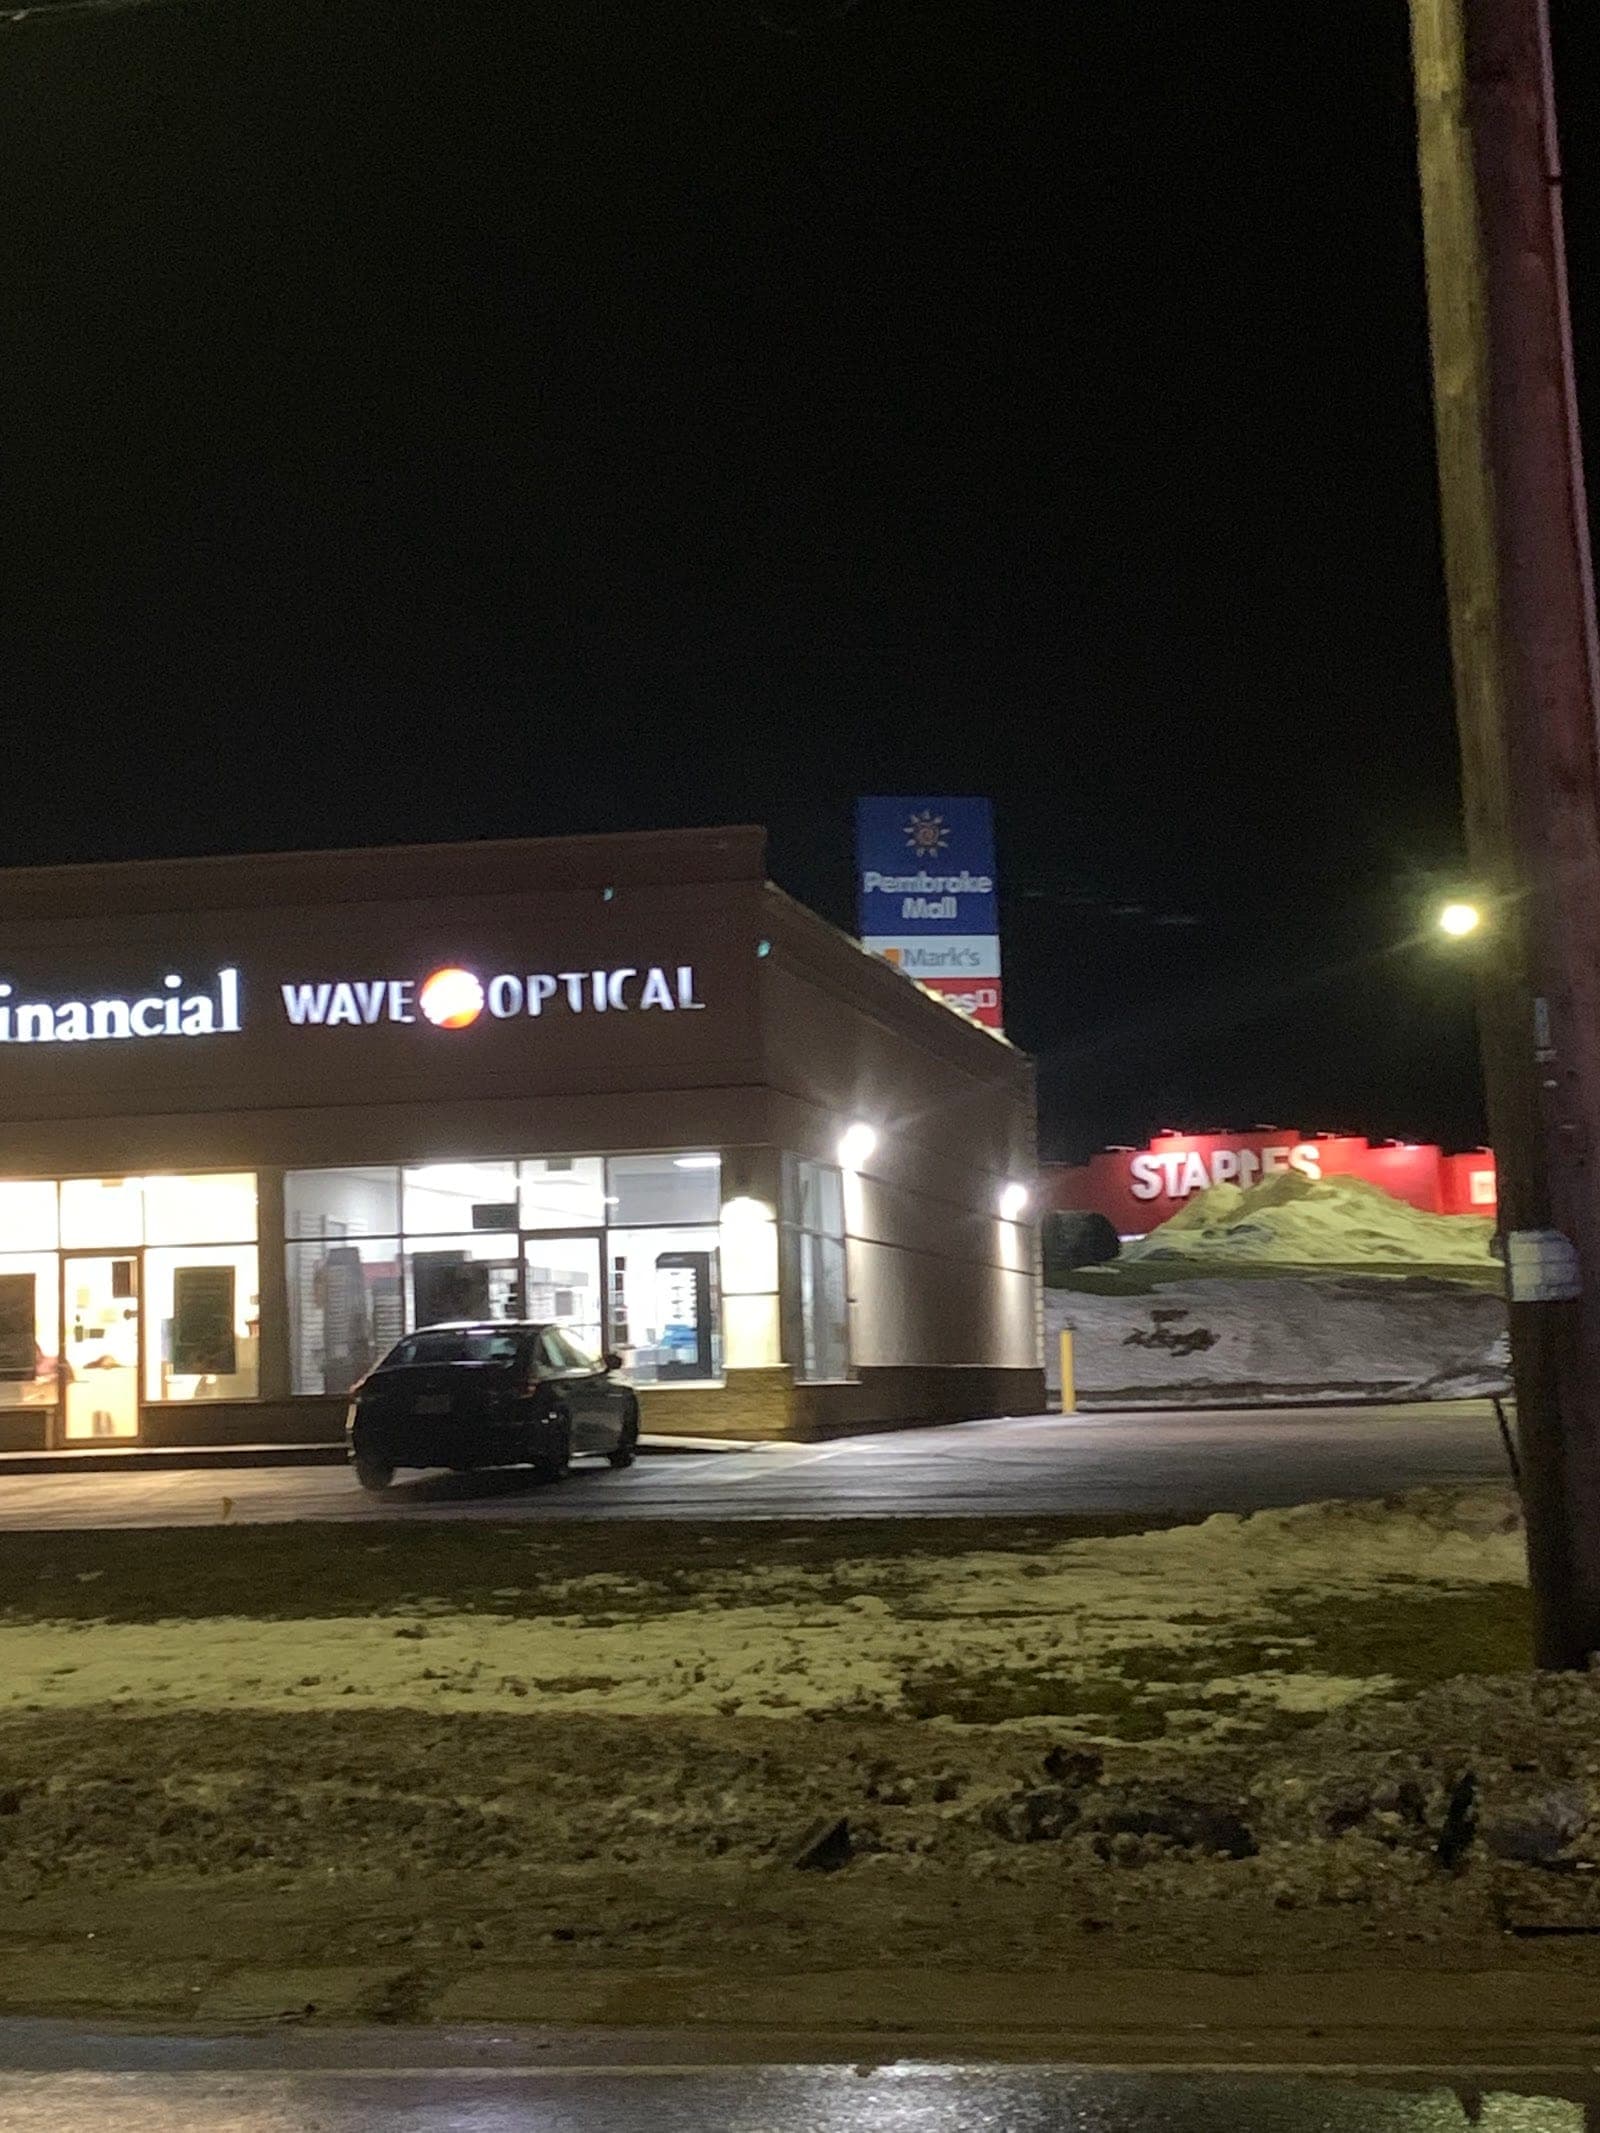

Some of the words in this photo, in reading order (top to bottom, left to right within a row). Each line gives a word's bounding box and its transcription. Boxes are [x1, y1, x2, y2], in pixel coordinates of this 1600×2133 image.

[863, 869, 993, 893] Pembroke
[902, 896, 958, 919] Mall
[903, 947, 981, 967] Mark's
[281, 979, 416, 1026] WAVE
[487, 965, 706, 1018] OPTICAL
